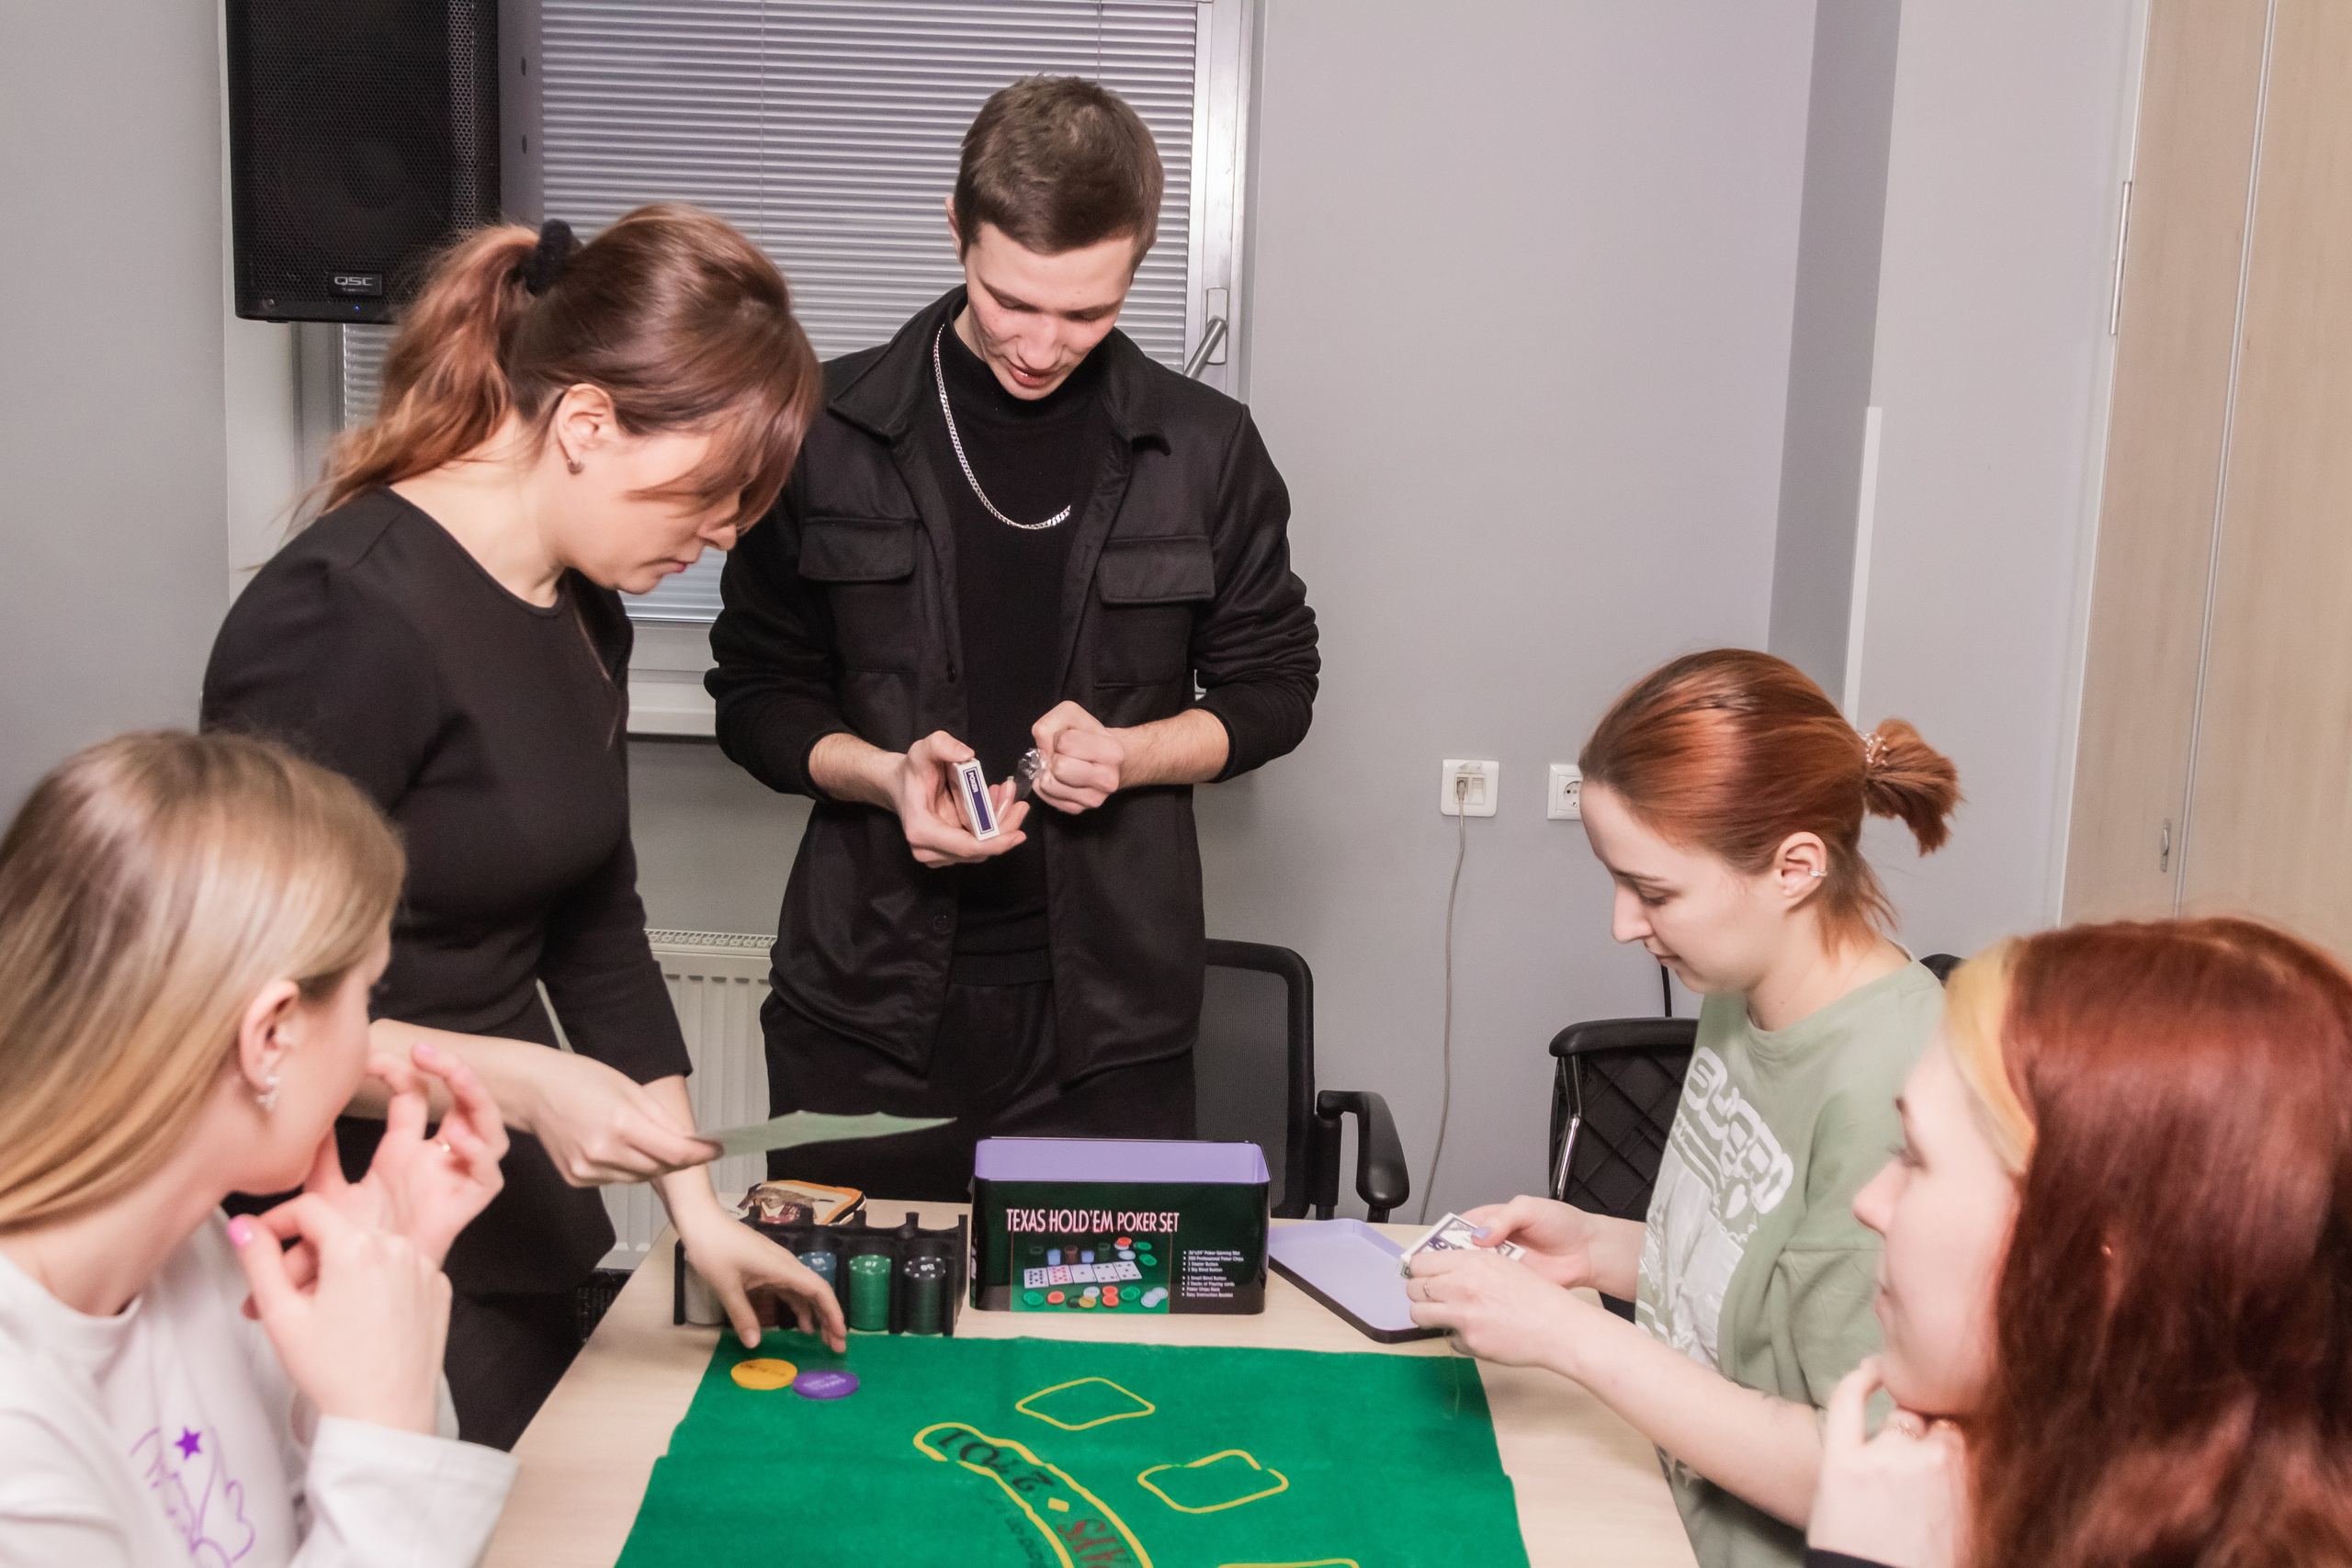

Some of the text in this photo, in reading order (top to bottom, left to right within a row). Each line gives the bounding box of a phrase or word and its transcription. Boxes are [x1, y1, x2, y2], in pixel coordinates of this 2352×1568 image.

[334, 276, 373, 287] QSC
[968, 772, 978, 793] POKER
[1006, 1208, 1180, 1233] TEXAS HOLD'EM POKER SET
[1057, 1518, 1132, 1568] AYS
